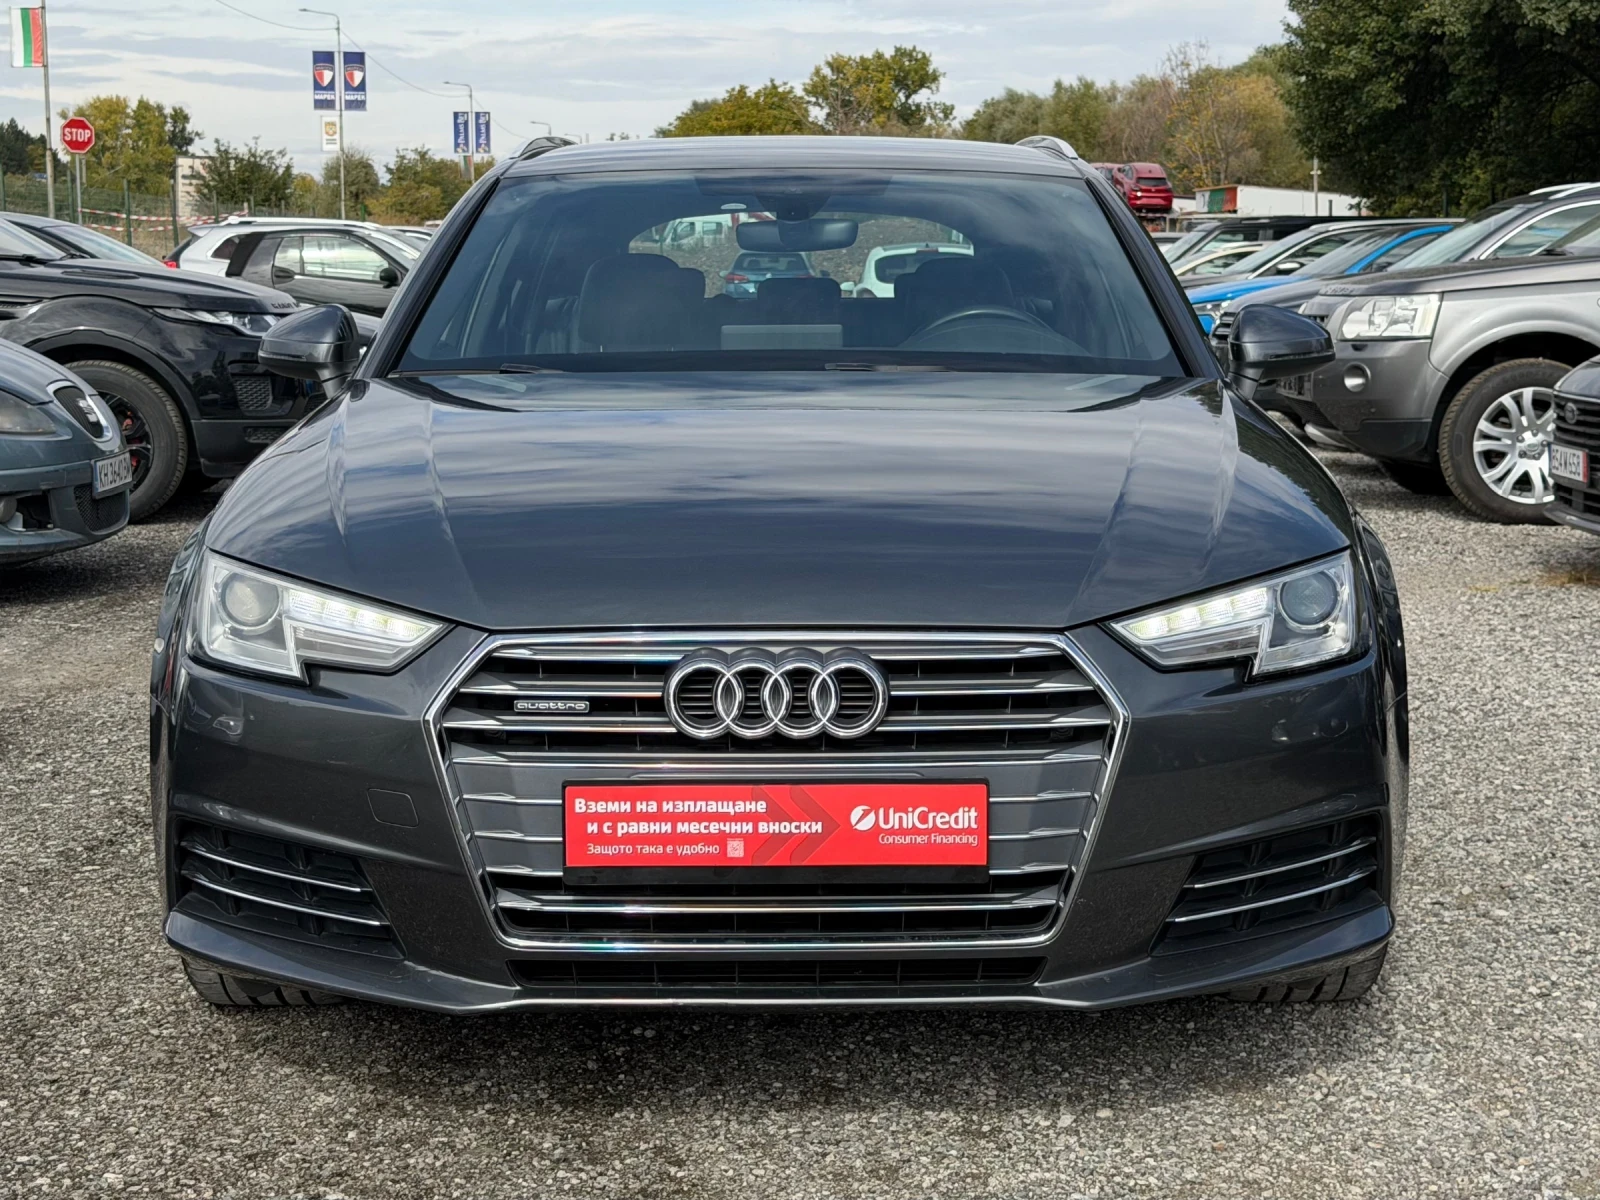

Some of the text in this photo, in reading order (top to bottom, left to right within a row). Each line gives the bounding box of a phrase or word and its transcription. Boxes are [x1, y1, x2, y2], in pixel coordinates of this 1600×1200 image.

[64, 127, 91, 142] STOP
[517, 702, 586, 711] quattro
[574, 798, 767, 816] Вземи на изплащане
[878, 806, 978, 830] UniCredit
[587, 821, 823, 837] и с равни месечни вноски
[878, 832, 978, 847] Consumer Financing
[586, 842, 720, 857] Защото така е удобно
